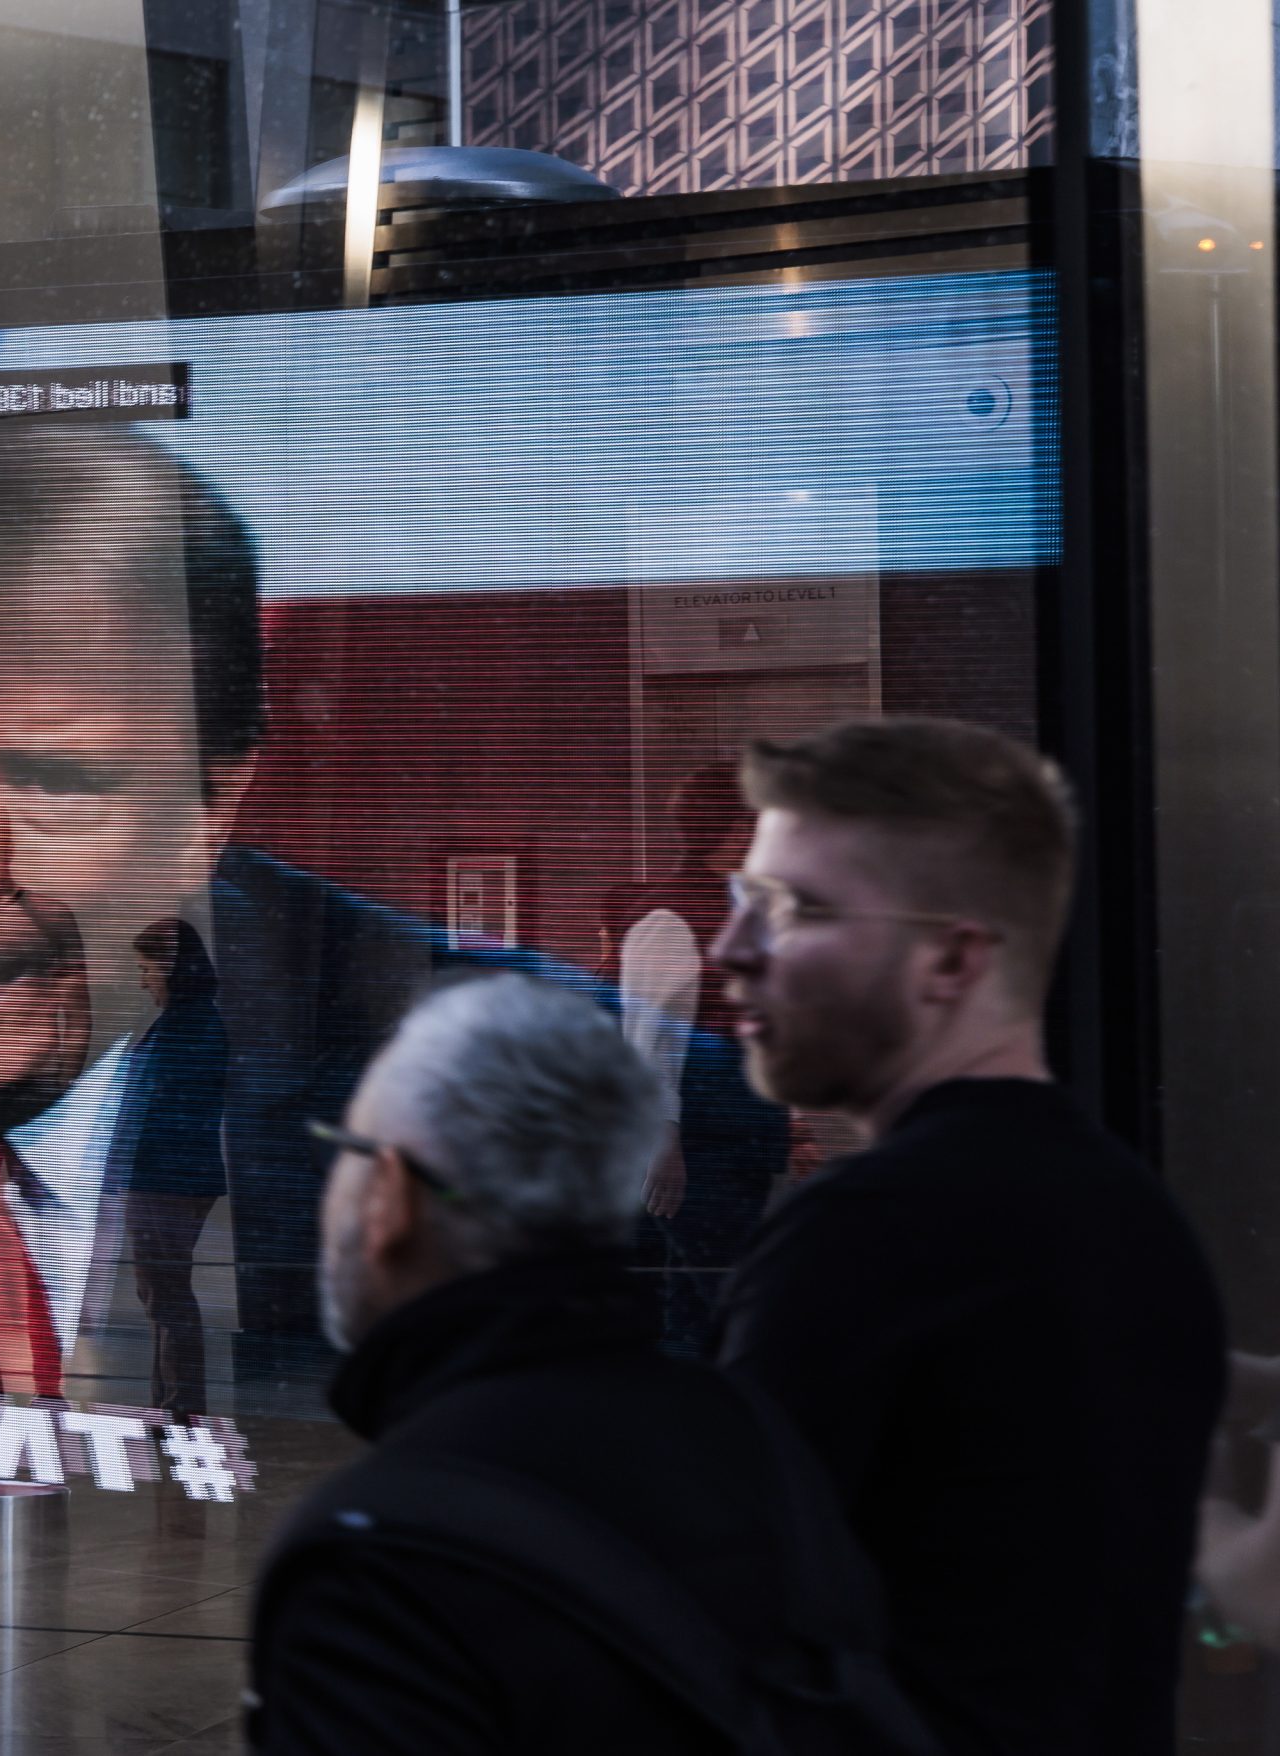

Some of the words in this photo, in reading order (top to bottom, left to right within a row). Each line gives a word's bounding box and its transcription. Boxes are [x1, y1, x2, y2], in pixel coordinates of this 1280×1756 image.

[674, 592, 751, 609] ELEVATOR
[752, 590, 775, 603] TO
[778, 587, 827, 601] LEVEL
[828, 586, 836, 599] 1
